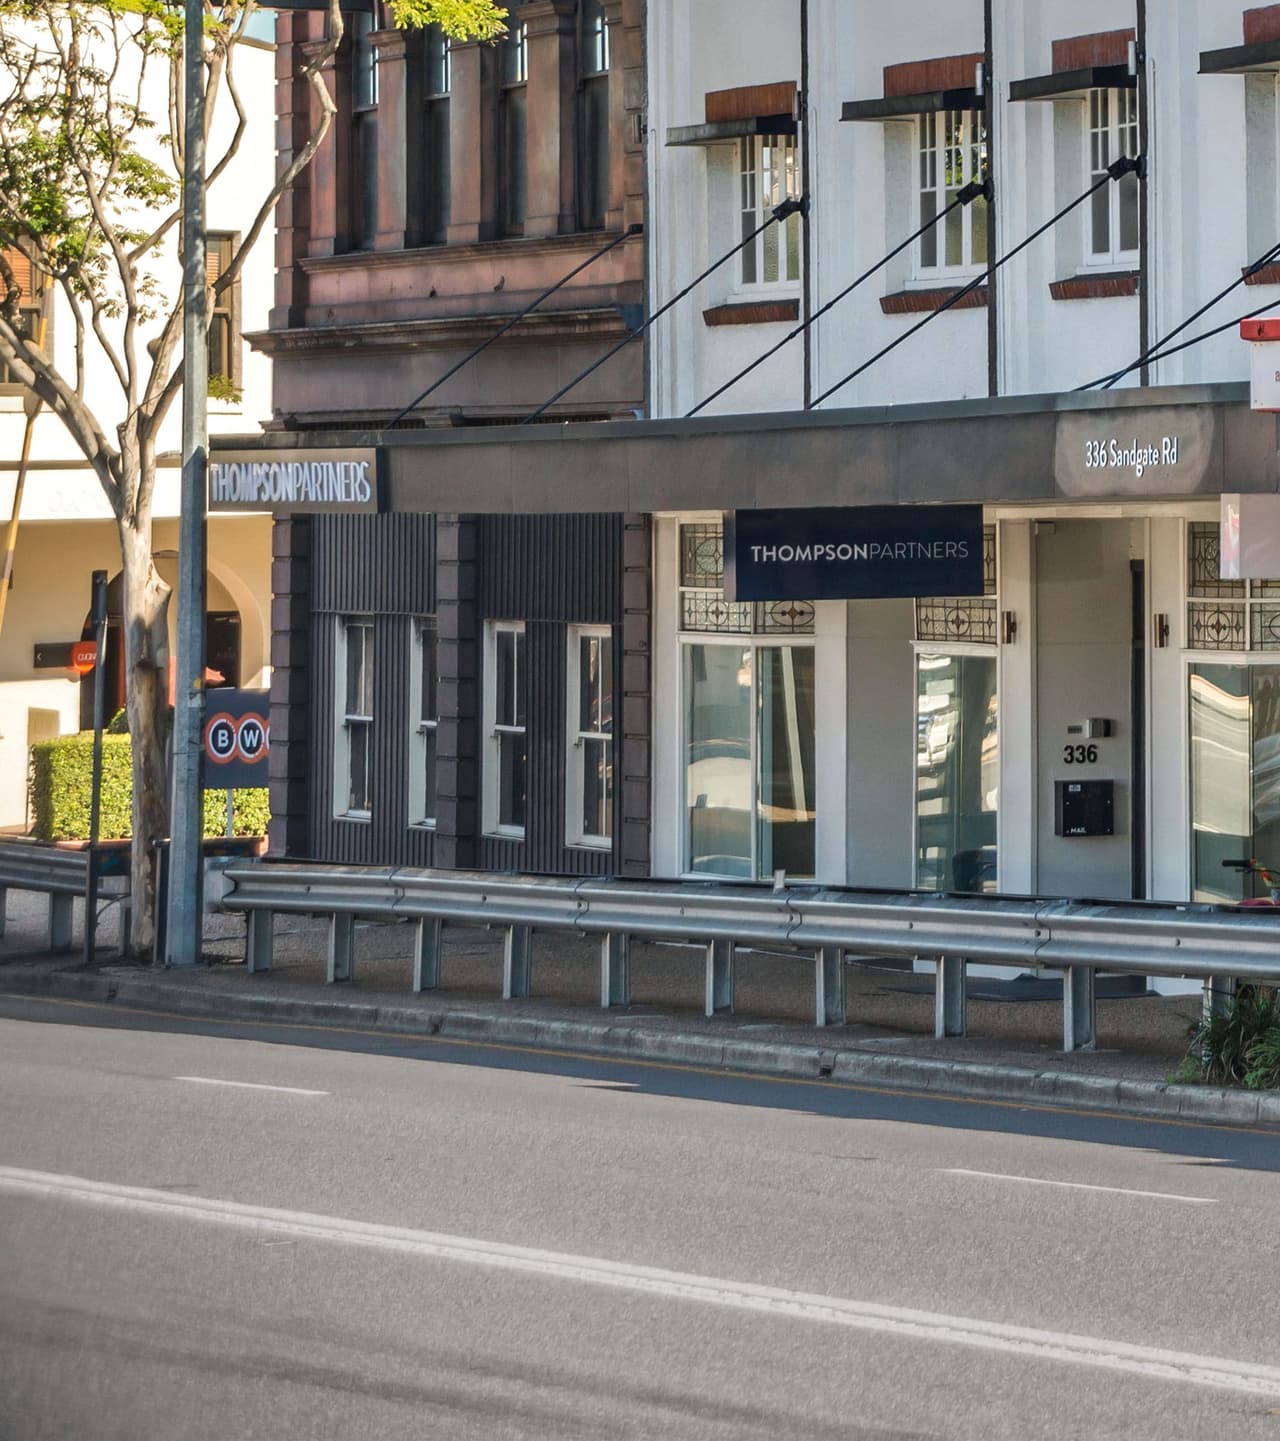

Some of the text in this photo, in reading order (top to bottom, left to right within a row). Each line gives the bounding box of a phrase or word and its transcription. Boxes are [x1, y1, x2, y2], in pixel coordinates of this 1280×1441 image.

[1085, 436, 1178, 477] 336 Sandgate Rd
[210, 462, 371, 502] THOMPSONPARTNERS
[751, 541, 969, 562] THOMPSONPARTNERS
[1063, 744, 1098, 764] 336
